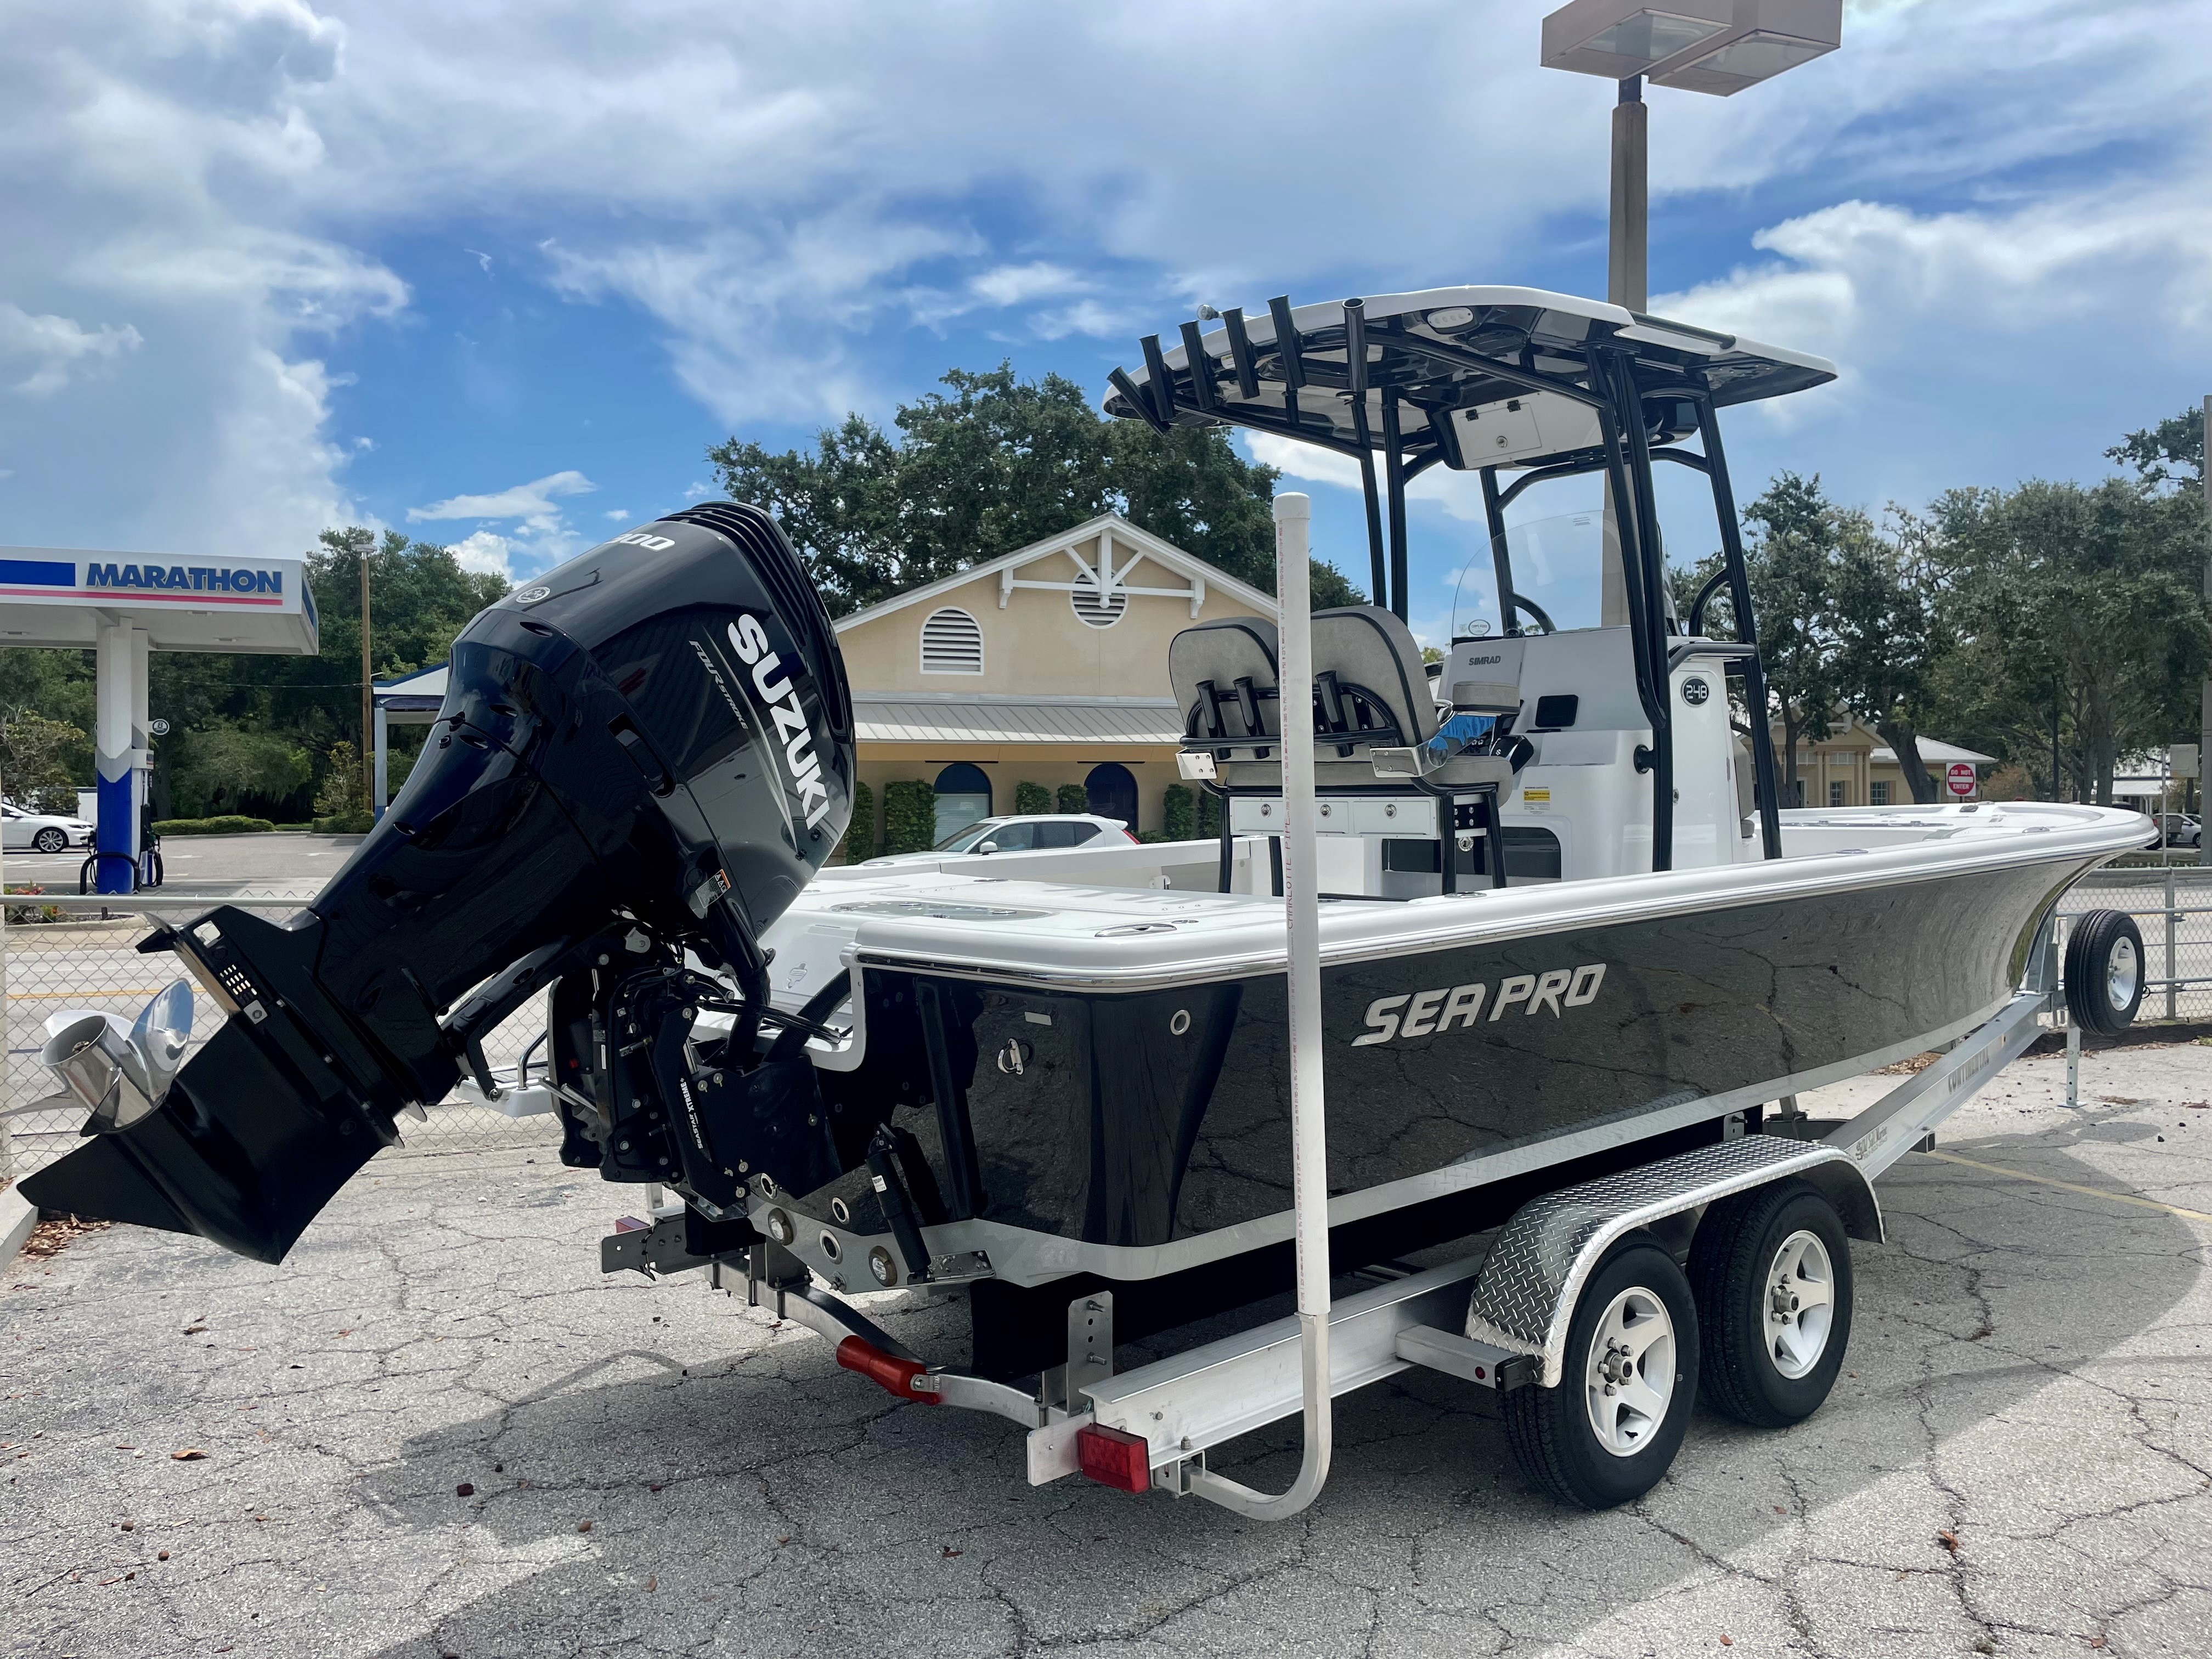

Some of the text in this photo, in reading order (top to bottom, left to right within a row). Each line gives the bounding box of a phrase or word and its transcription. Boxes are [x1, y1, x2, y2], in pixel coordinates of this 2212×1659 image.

[87, 562, 282, 593] MARATHON
[1469, 656, 1501, 665] SIMRAD
[1686, 685, 1707, 699] 248
[727, 614, 830, 830] SUZUKI
[1285, 857, 1293, 929] CHARLOTTE
[1351, 963, 1606, 1046] SEA PRO
[680, 1081, 695, 1113] XTREME
